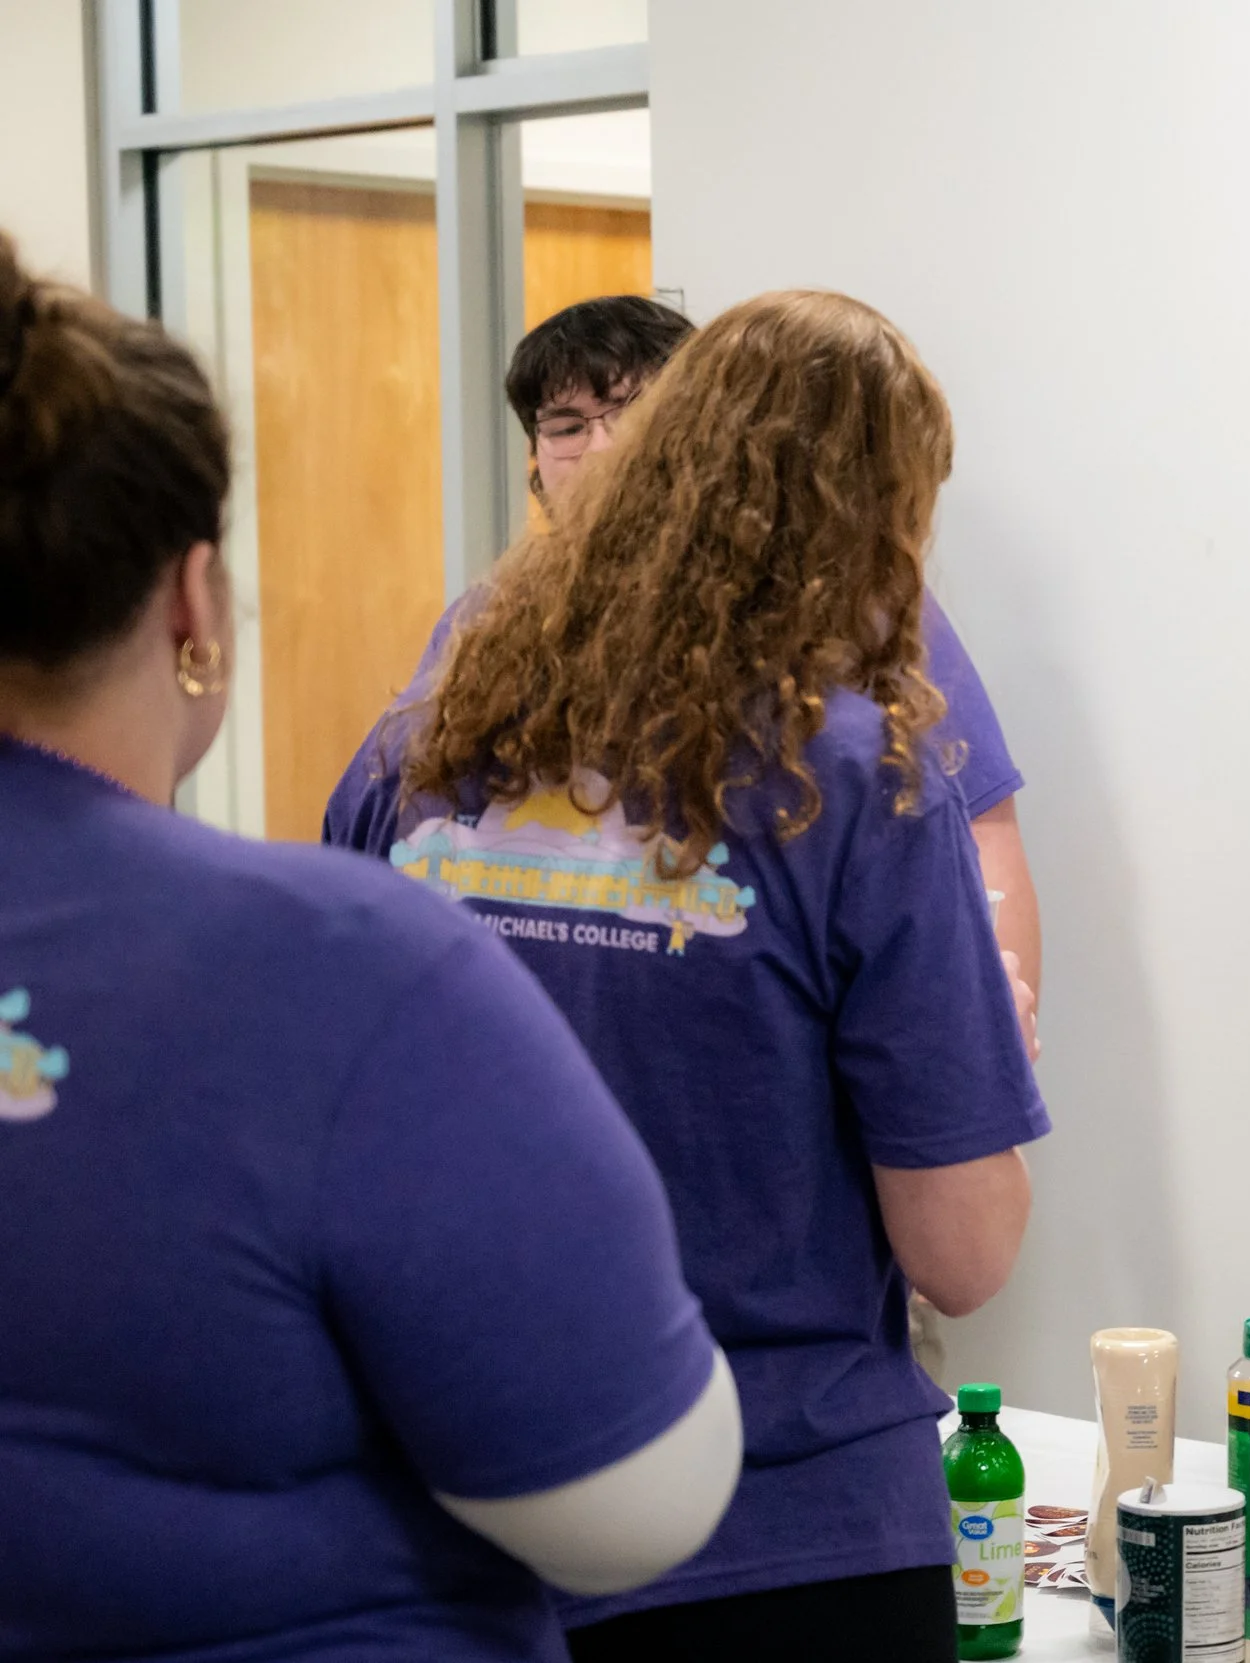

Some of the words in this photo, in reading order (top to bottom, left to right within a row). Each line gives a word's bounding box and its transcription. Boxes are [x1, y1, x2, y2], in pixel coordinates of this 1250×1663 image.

[573, 924, 660, 953] COLLEGE
[1185, 1525, 1229, 1536] Nutrition
[979, 1541, 1021, 1561] Lime
